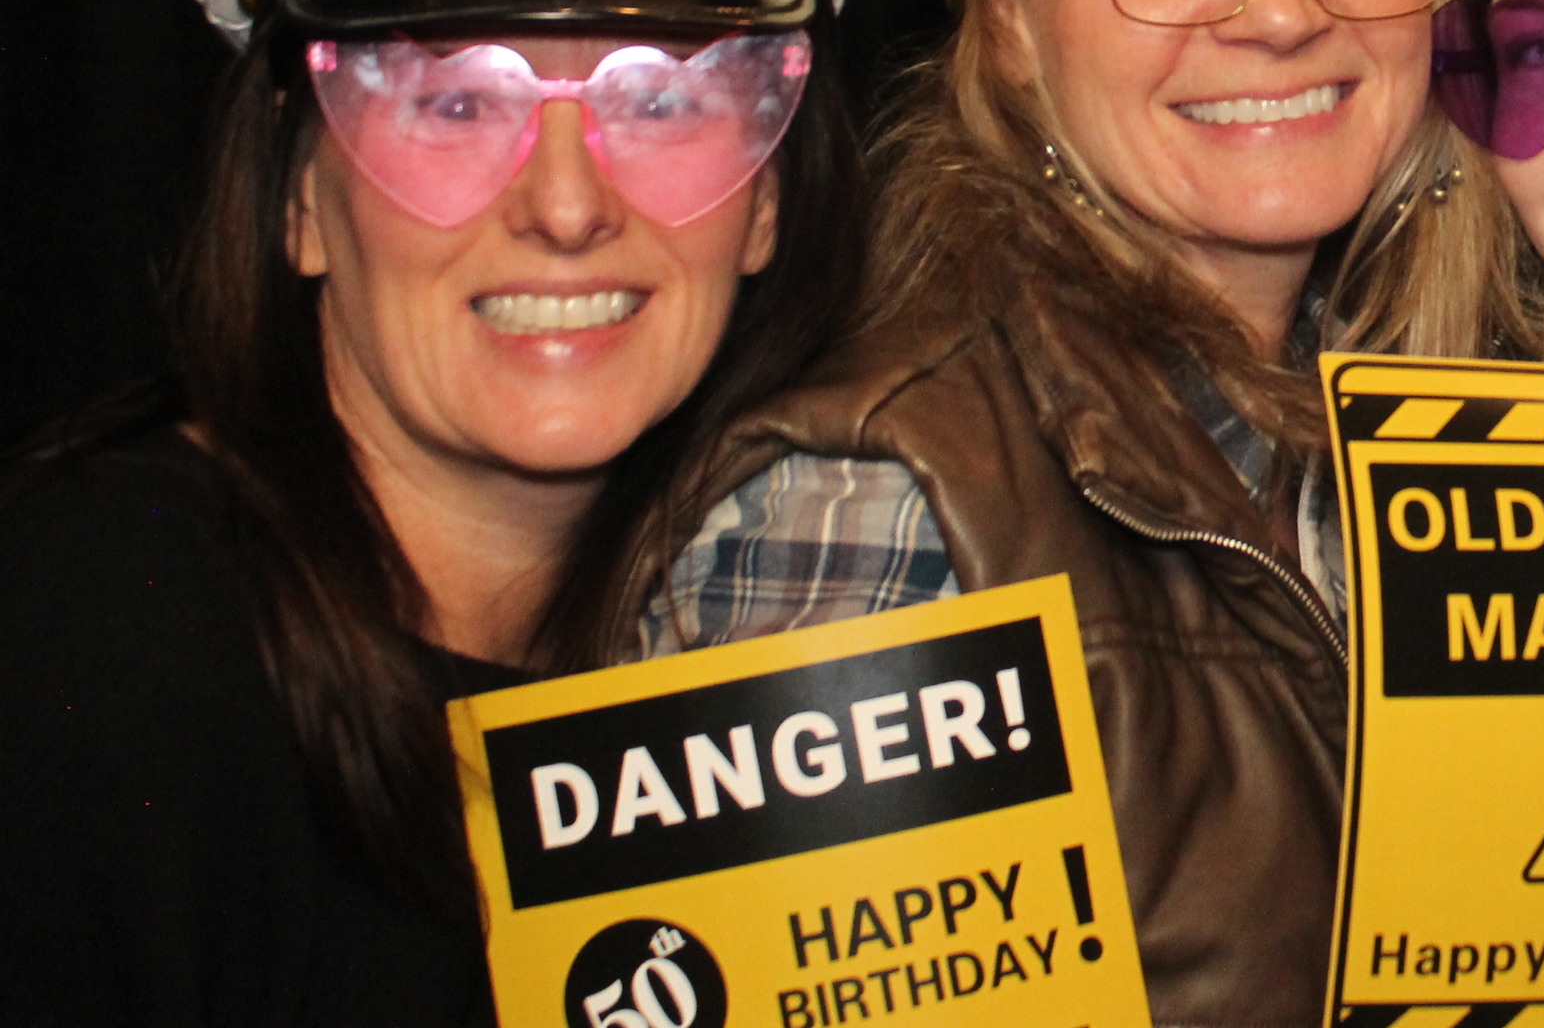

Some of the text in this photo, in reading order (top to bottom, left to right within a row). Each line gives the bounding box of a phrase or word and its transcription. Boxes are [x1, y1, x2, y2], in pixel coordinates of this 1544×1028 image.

[529, 667, 1032, 850] DANGER!
[788, 862, 1024, 969] HAPPY
[777, 928, 1059, 1028] BIRTHDAY
